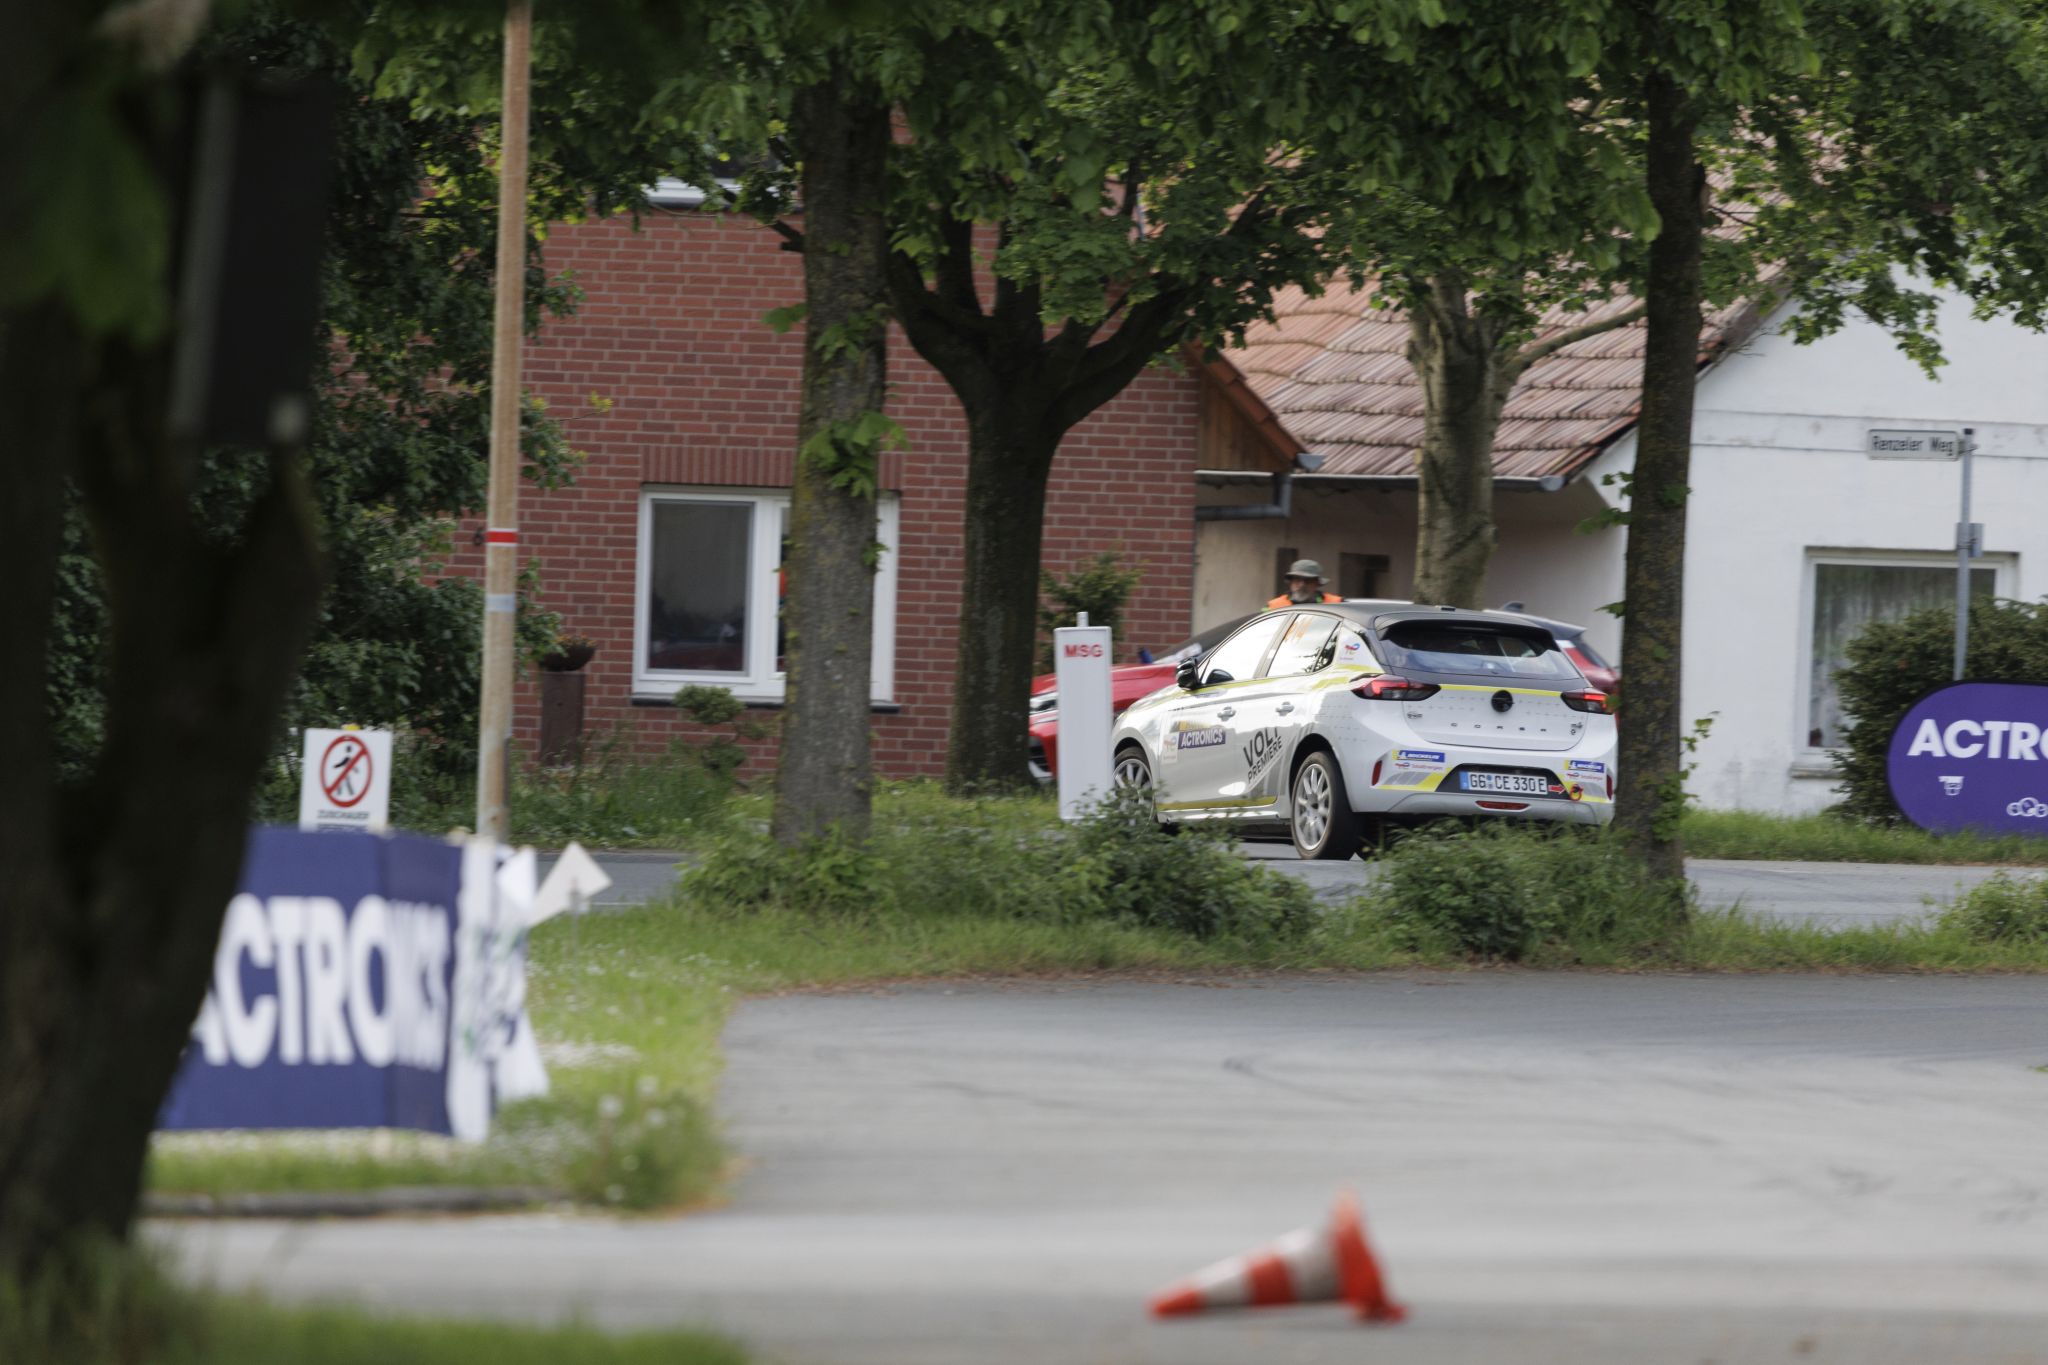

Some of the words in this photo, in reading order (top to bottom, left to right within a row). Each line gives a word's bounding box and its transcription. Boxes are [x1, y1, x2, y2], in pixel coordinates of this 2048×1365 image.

[1929, 437, 1953, 456] Weg
[1064, 644, 1103, 657] MSG
[1181, 729, 1223, 747] ACTRONICS
[1907, 718, 2048, 760] ACTR
[1247, 735, 1282, 783] PREMIERE
[1470, 774, 1486, 788] GG
[1494, 775, 1510, 790] CE
